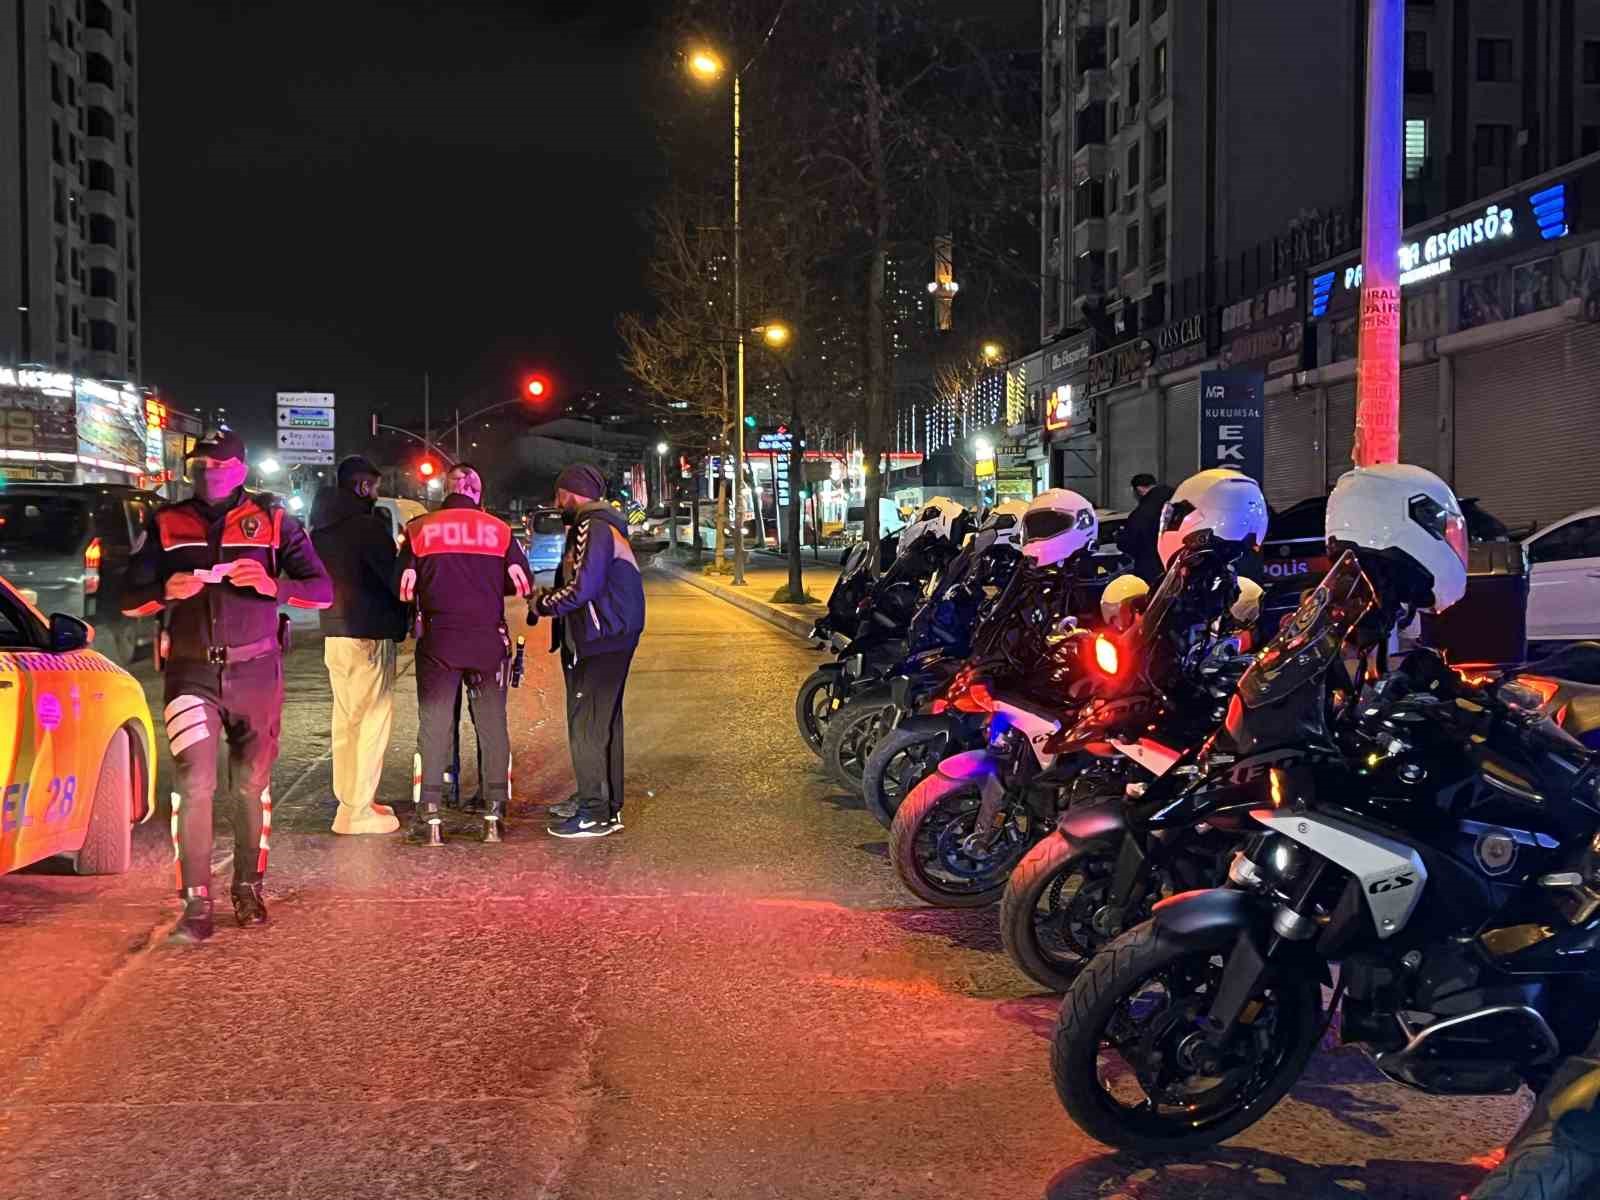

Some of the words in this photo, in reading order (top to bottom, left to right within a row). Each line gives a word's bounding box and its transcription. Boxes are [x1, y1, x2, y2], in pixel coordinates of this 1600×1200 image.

[1205, 408, 1261, 417] KURUMSAL
[1217, 425, 1245, 469] EK
[45, 775, 76, 823] 28
[1369, 872, 1414, 894] GS
